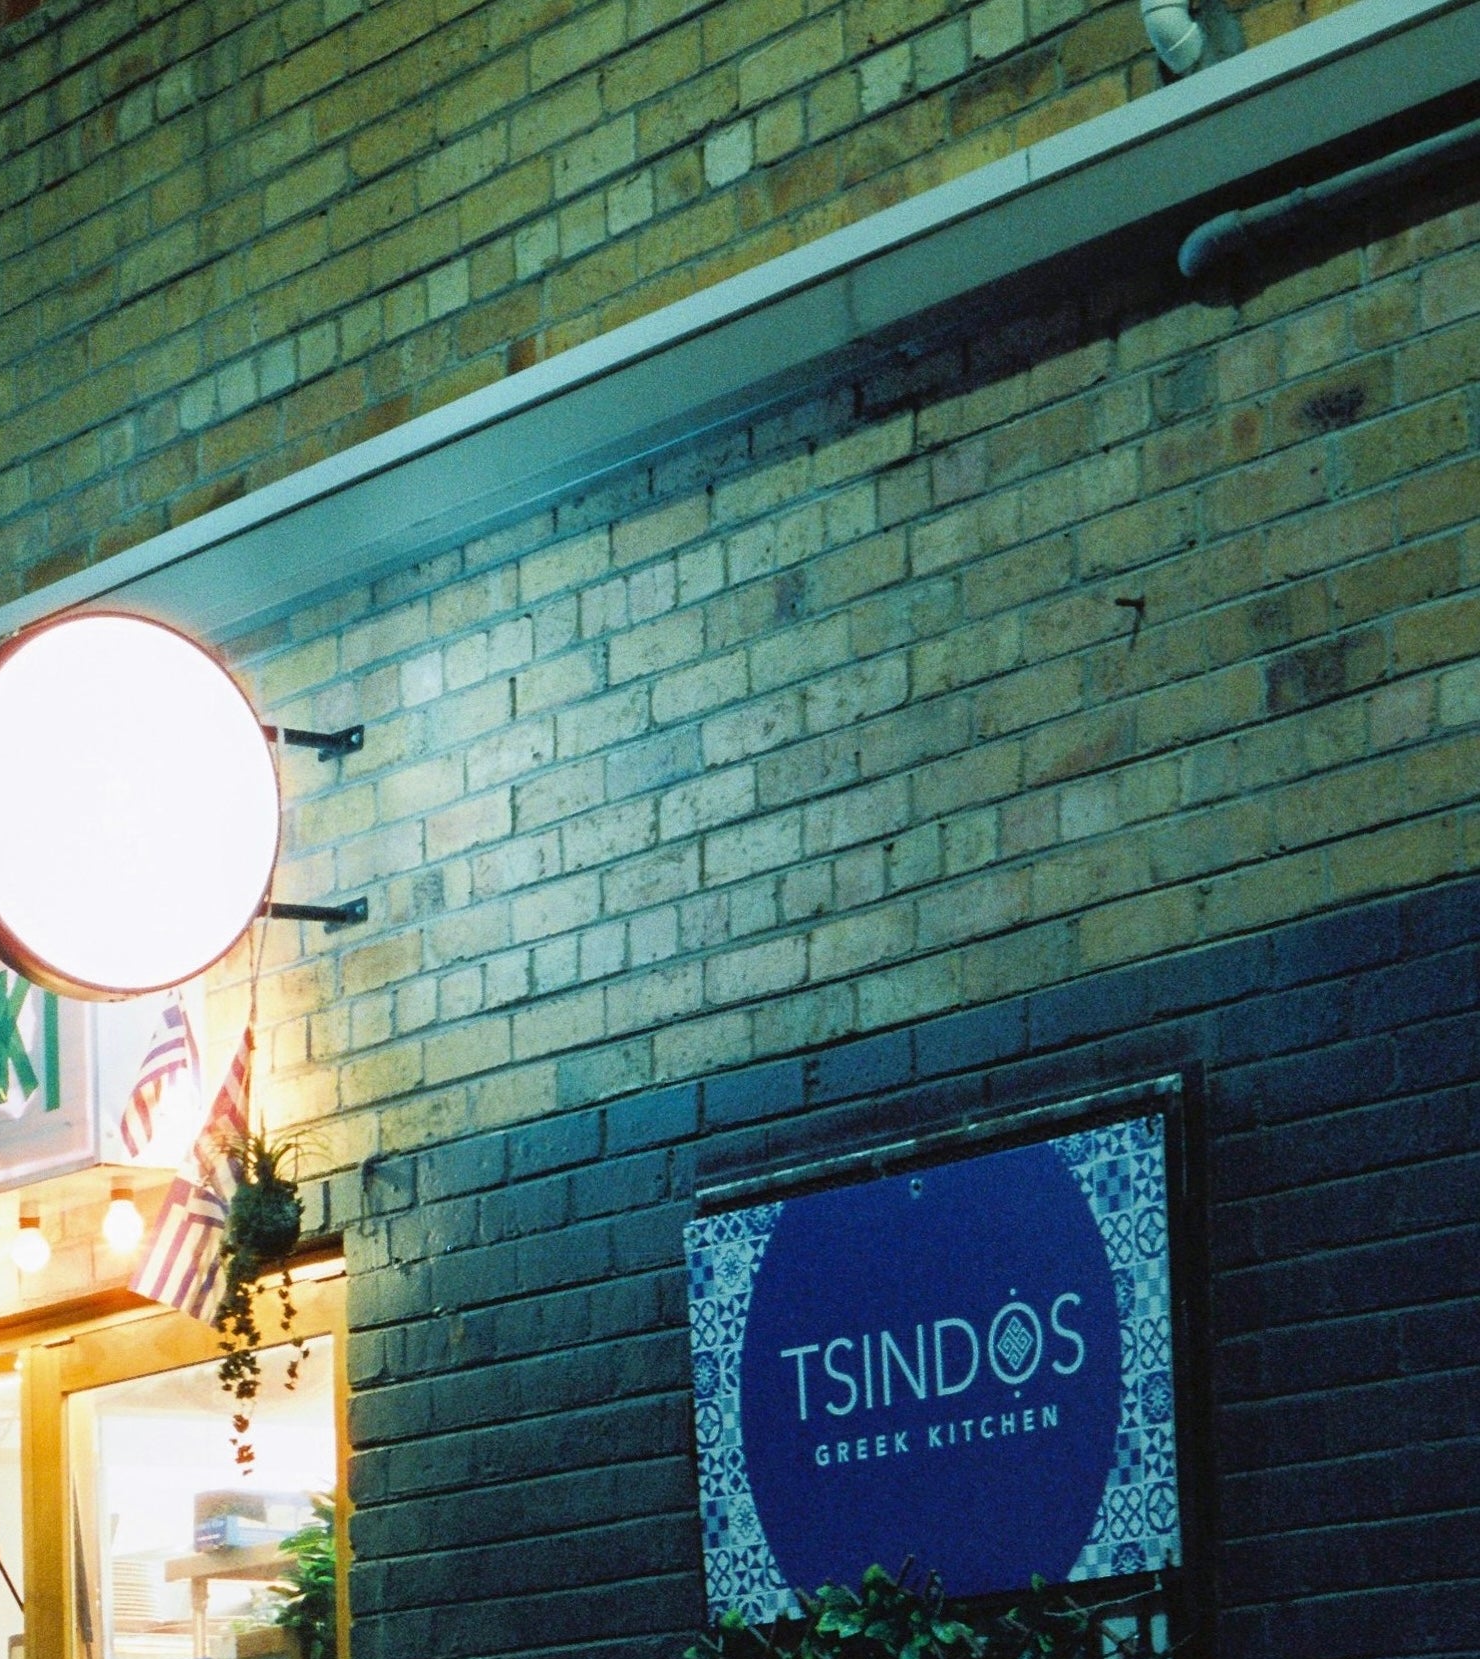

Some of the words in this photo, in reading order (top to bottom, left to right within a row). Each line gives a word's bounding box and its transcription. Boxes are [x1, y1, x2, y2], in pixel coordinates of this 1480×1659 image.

[780, 1288, 1086, 1422] TSINDOS
[813, 1430, 911, 1468] GREEK
[927, 1403, 1061, 1449] KITCHEN
